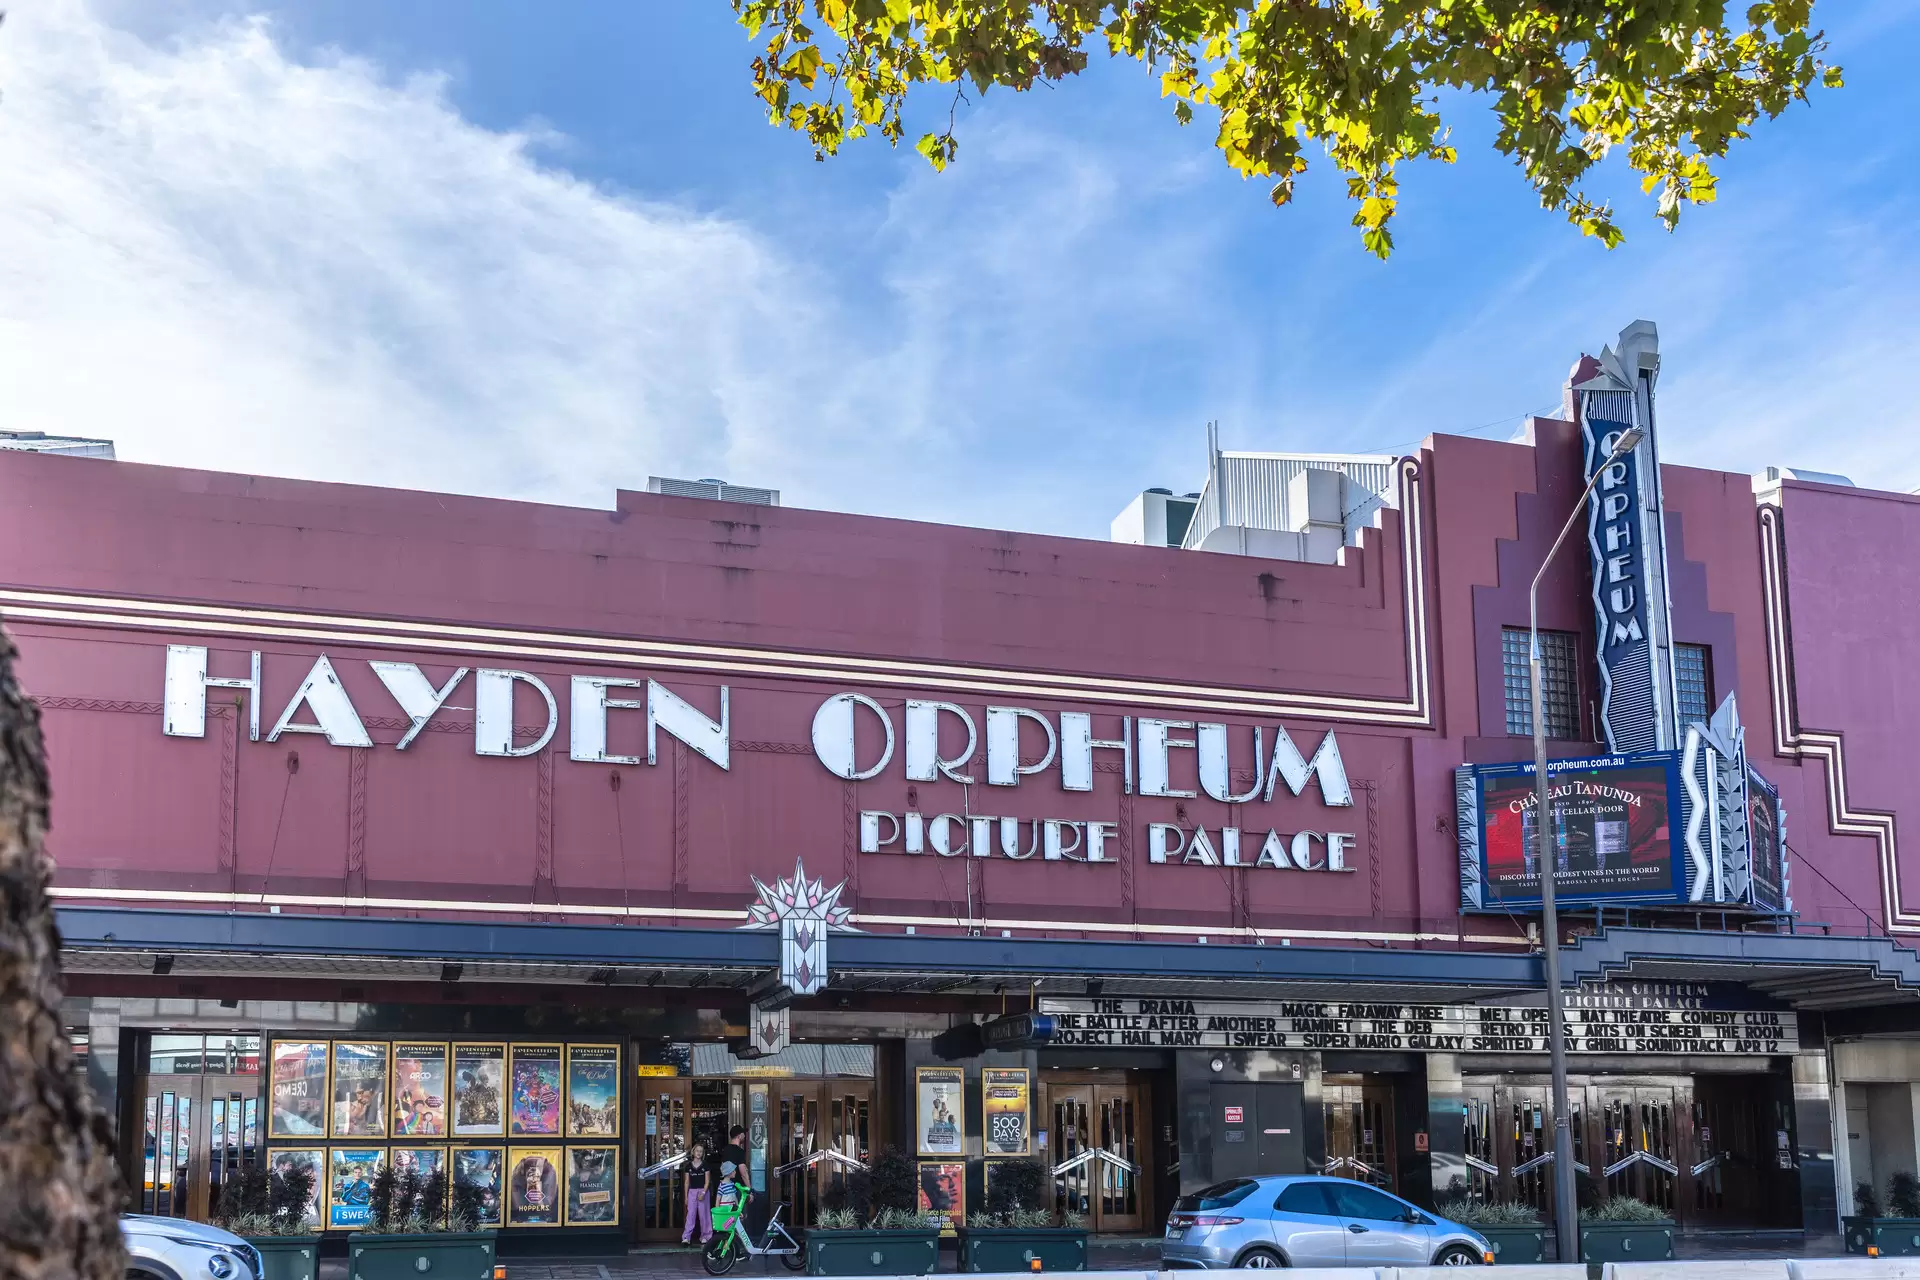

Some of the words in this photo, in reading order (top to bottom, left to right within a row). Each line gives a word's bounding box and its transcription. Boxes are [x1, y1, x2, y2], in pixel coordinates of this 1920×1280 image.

[1600, 431, 1644, 646] ORPHEUM
[163, 644, 730, 771] HAYDEN
[811, 692, 1354, 807] ORPHEUM
[1523, 756, 1625, 773] ww.orpheum.com.au
[1509, 784, 1572, 814] CHÂEAU
[1573, 780, 1642, 807] TANUNDA
[1526, 809, 1560, 818] SYEY
[1562, 807, 1596, 816] CELLAR
[1597, 804, 1624, 813] DOOR
[859, 810, 1118, 863] PICTURE
[1148, 823, 1358, 872] PALACE
[1499, 873, 1536, 881] DISCOVER
[1552, 870, 1580, 878] OLDEST
[1581, 869, 1604, 877] VINES
[1632, 866, 1660, 874] WORLD
[1632, 983, 1708, 996] ORPHEUM
[1091, 999, 1123, 1013] THE
[1139, 1000, 1196, 1015] DRAMA
[1282, 1003, 1329, 1017] MAGIC
[1338, 1004, 1403, 1019] FARAWAY
[1409, 1006, 1443, 1020] TREE
[1565, 995, 1633, 1008] PICTURE
[1642, 996, 1704, 1009] PALACE
[1086, 1014, 1142, 1029] BATTLE
[1147, 1015, 1199, 1030] AFTER
[1207, 1017, 1276, 1032] ANOTHER
[1292, 1018, 1353, 1033] HAMNET
[1370, 1020, 1398, 1034] THE
[1404, 1020, 1433, 1034] DEB
[1479, 1008, 1511, 1021] MET
[1580, 1010, 1607, 1023] NAT
[1612, 1010, 1670, 1024] THEATRE
[1681, 1011, 1737, 1025] COMEDY
[1744, 1012, 1779, 1025] CLUB
[1480, 1023, 1526, 1036] RETRO
[1531, 1023, 1573, 1037] FILS
[1585, 1024, 1620, 1037] ARTS
[1625, 1025, 1645, 1038] ON
[1650, 1025, 1702, 1038] SCREEN
[1714, 1026, 1740, 1039] THE
[1745, 1026, 1784, 1039] ROOM
[1055, 1030, 1114, 1045] ROJECT
[1122, 1031, 1155, 1045] HAIL
[1160, 1031, 1204, 1046] MARY
[1225, 1032, 1230, 1046] I
[1234, 1032, 1287, 1047] SWEAR
[1303, 1033, 1350, 1048] SUPER
[1355, 1034, 1401, 1048] MARIO
[1408, 1035, 1465, 1049] GALAXY
[1472, 1037, 1533, 1050] SPIRITED
[1542, 1037, 1579, 1051] AAY
[1586, 1038, 1628, 1051] GHIBLI
[1635, 1039, 1726, 1052] SOUNDTRACK
[1734, 1039, 1761, 1053] APR
[1766, 1040, 1779, 1053] 12
[409, 1071, 432, 1080] ARCO
[993, 1116, 1020, 1129] 500
[993, 1128, 1020, 1138] DAYS
[342, 1211, 373, 1219] SWEA
[518, 1204, 550, 1212] HOPPERS
